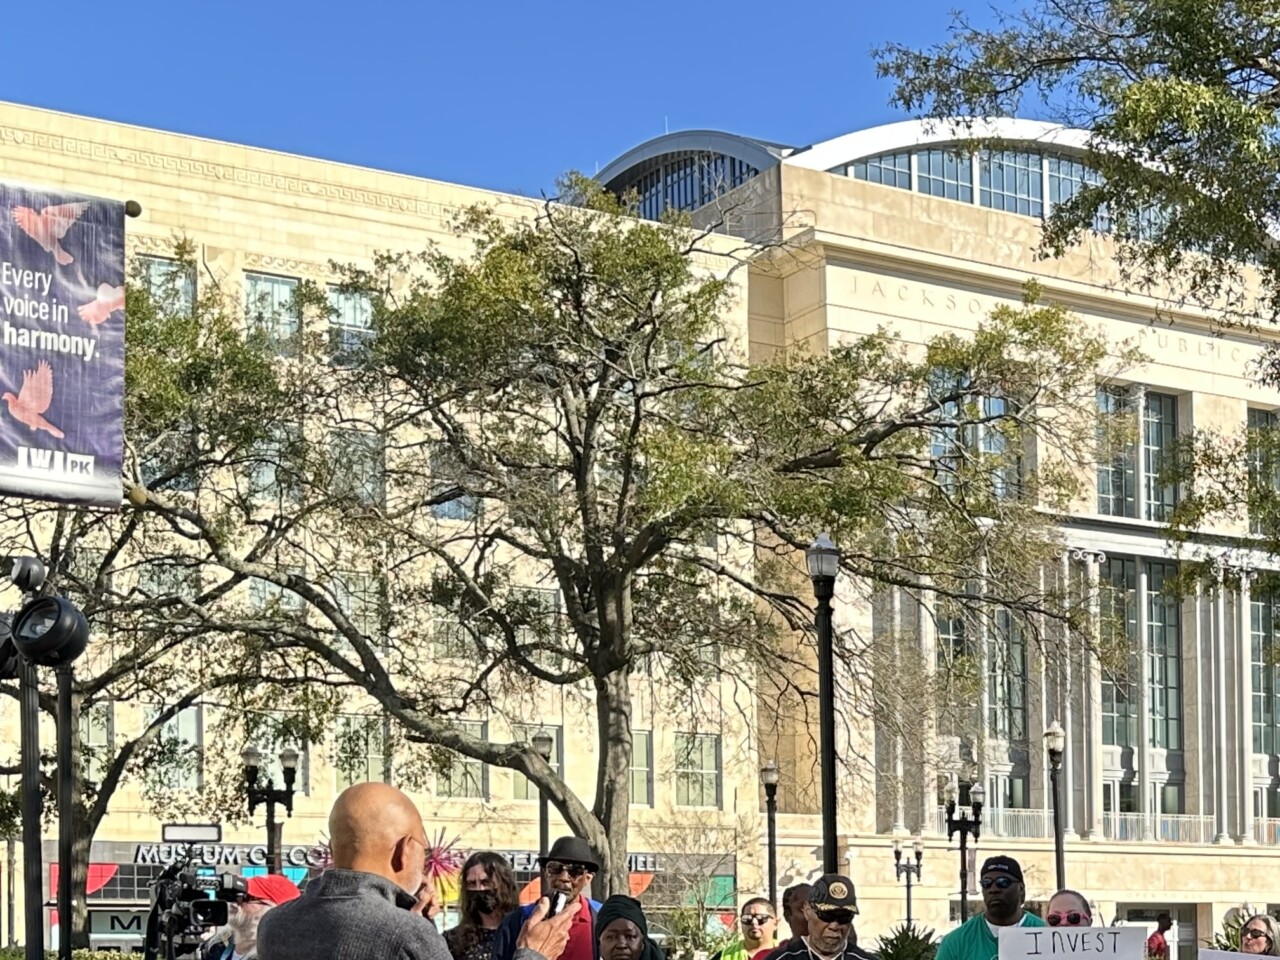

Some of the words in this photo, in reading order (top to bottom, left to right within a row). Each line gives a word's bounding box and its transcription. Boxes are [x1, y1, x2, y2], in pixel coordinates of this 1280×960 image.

[2, 261, 52, 296] Every
[3, 294, 49, 320] voice
[53, 298, 68, 323] in
[3, 321, 100, 362] harmony.
[1138, 329, 1242, 361] PUBLIC
